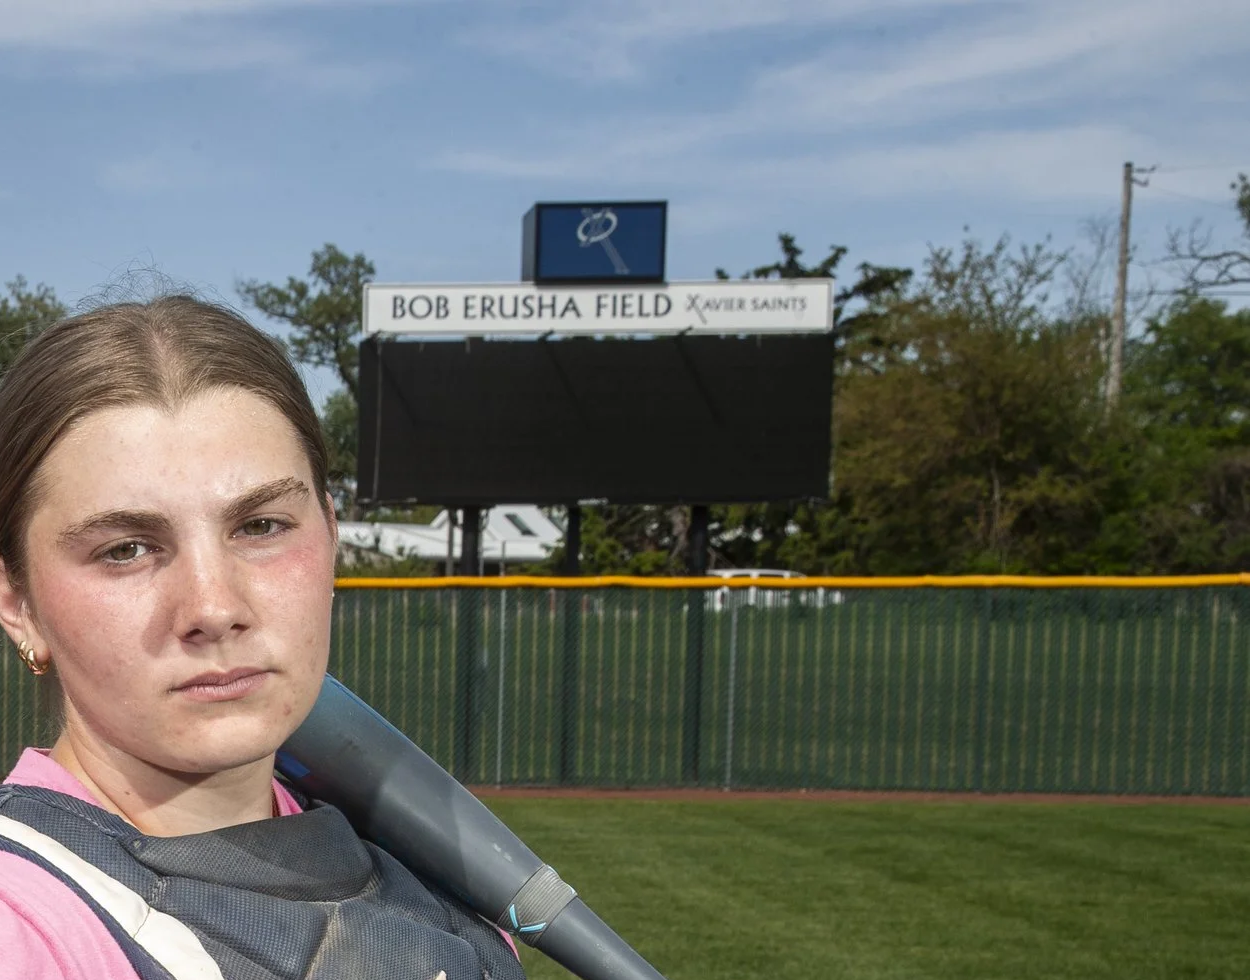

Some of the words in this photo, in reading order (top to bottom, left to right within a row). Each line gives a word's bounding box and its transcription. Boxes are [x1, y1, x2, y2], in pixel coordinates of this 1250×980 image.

[392, 295, 449, 319] BOB
[463, 294, 582, 319] ERUSHA
[595, 293, 672, 318] FIELD
[750, 296, 807, 312] SAINTS
